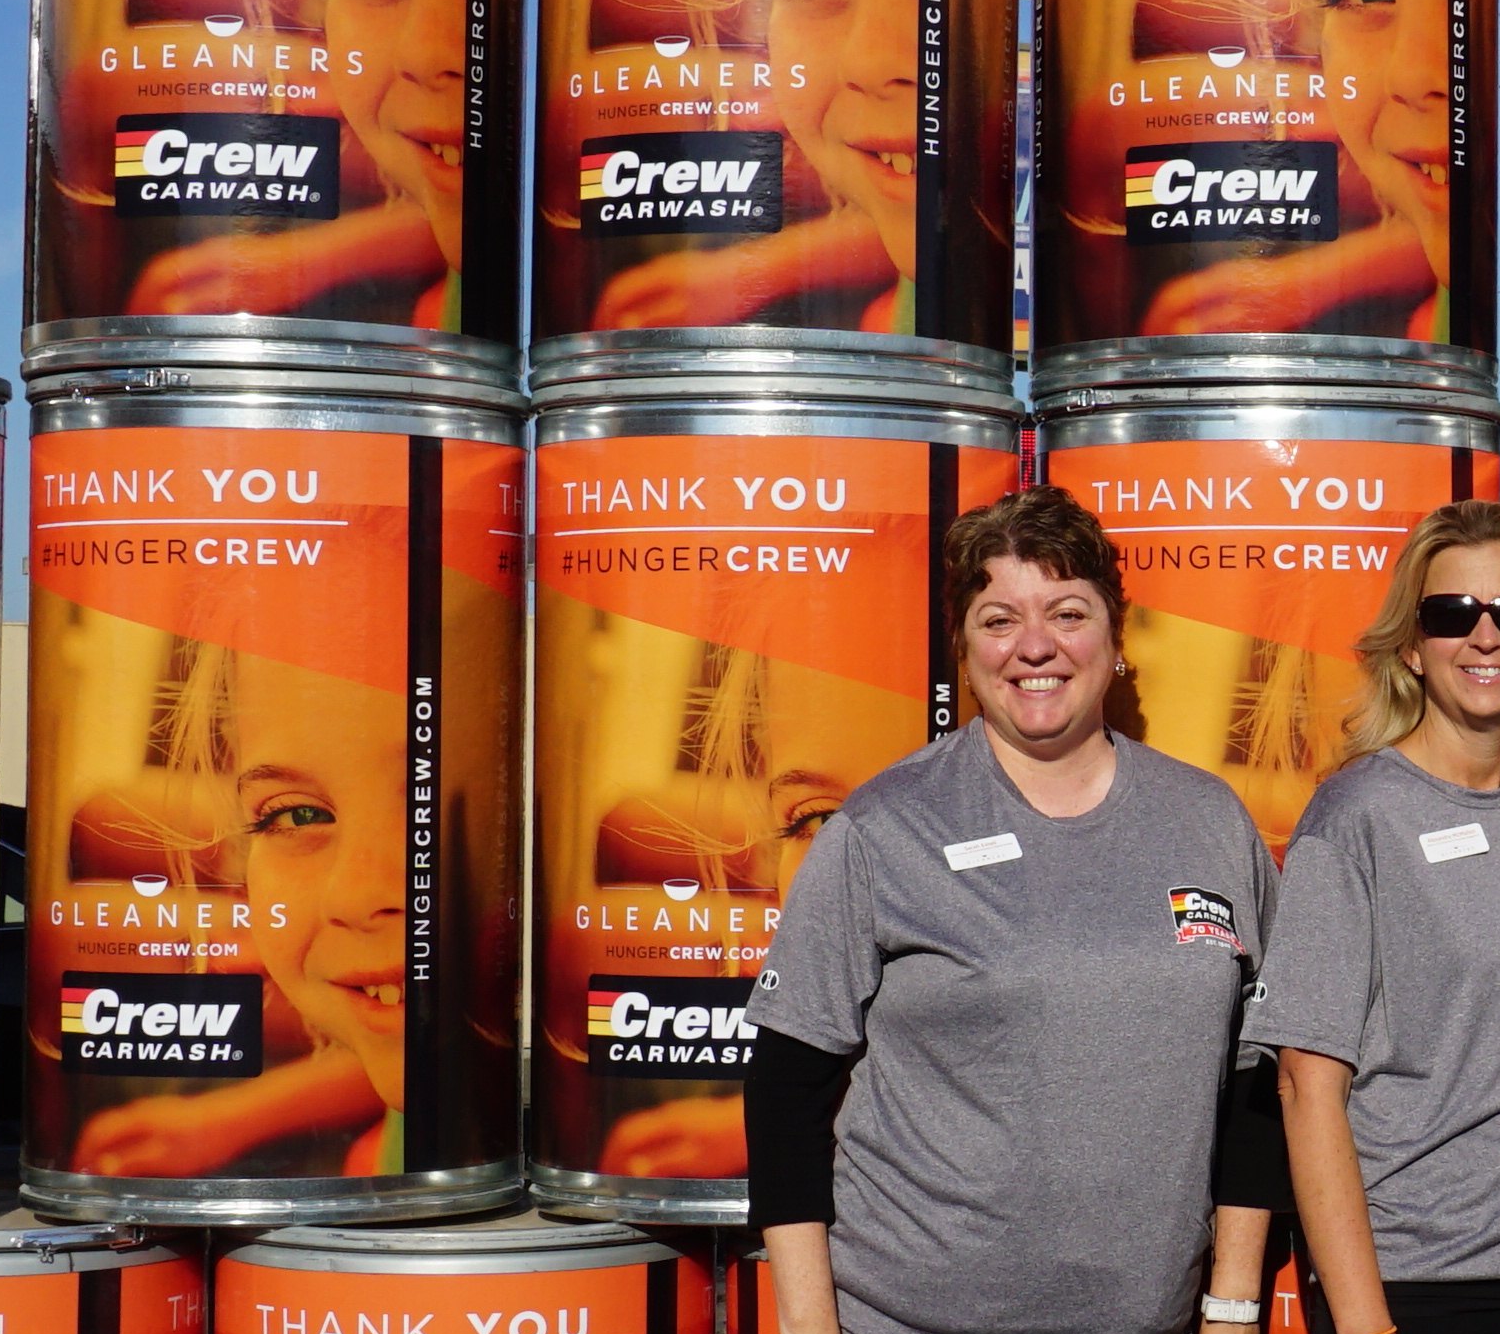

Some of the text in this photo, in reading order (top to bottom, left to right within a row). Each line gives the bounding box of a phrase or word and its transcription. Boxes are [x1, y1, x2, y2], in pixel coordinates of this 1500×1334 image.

[101, 44, 363, 75] GLEANERS
[138, 82, 317, 100] HUNGERCREW.COM
[570, 64, 806, 98] GLEANERS
[1109, 75, 1357, 106] GLEANERS
[597, 101, 759, 120] HUNGERCREW.COM
[1145, 110, 1315, 129] HUNGERCREW.COM
[142, 129, 319, 178] Crew
[601, 150, 761, 197] Crew
[1152, 159, 1318, 205] Crew
[44, 468, 318, 507] THANK YOU
[563, 476, 847, 515] THANK YOU
[1092, 476, 1384, 513] THANK YOU
[42, 538, 322, 568] #HUNGERCREW
[563, 545, 850, 575] #HUNGERCREW
[1117, 544, 1388, 571] HUNGERCREW
[51, 902, 287, 928] GLEANERS
[577, 905, 780, 931] GLEANER
[77, 941, 238, 957] HUNGERCREW.COM
[82, 988, 240, 1036] Crew
